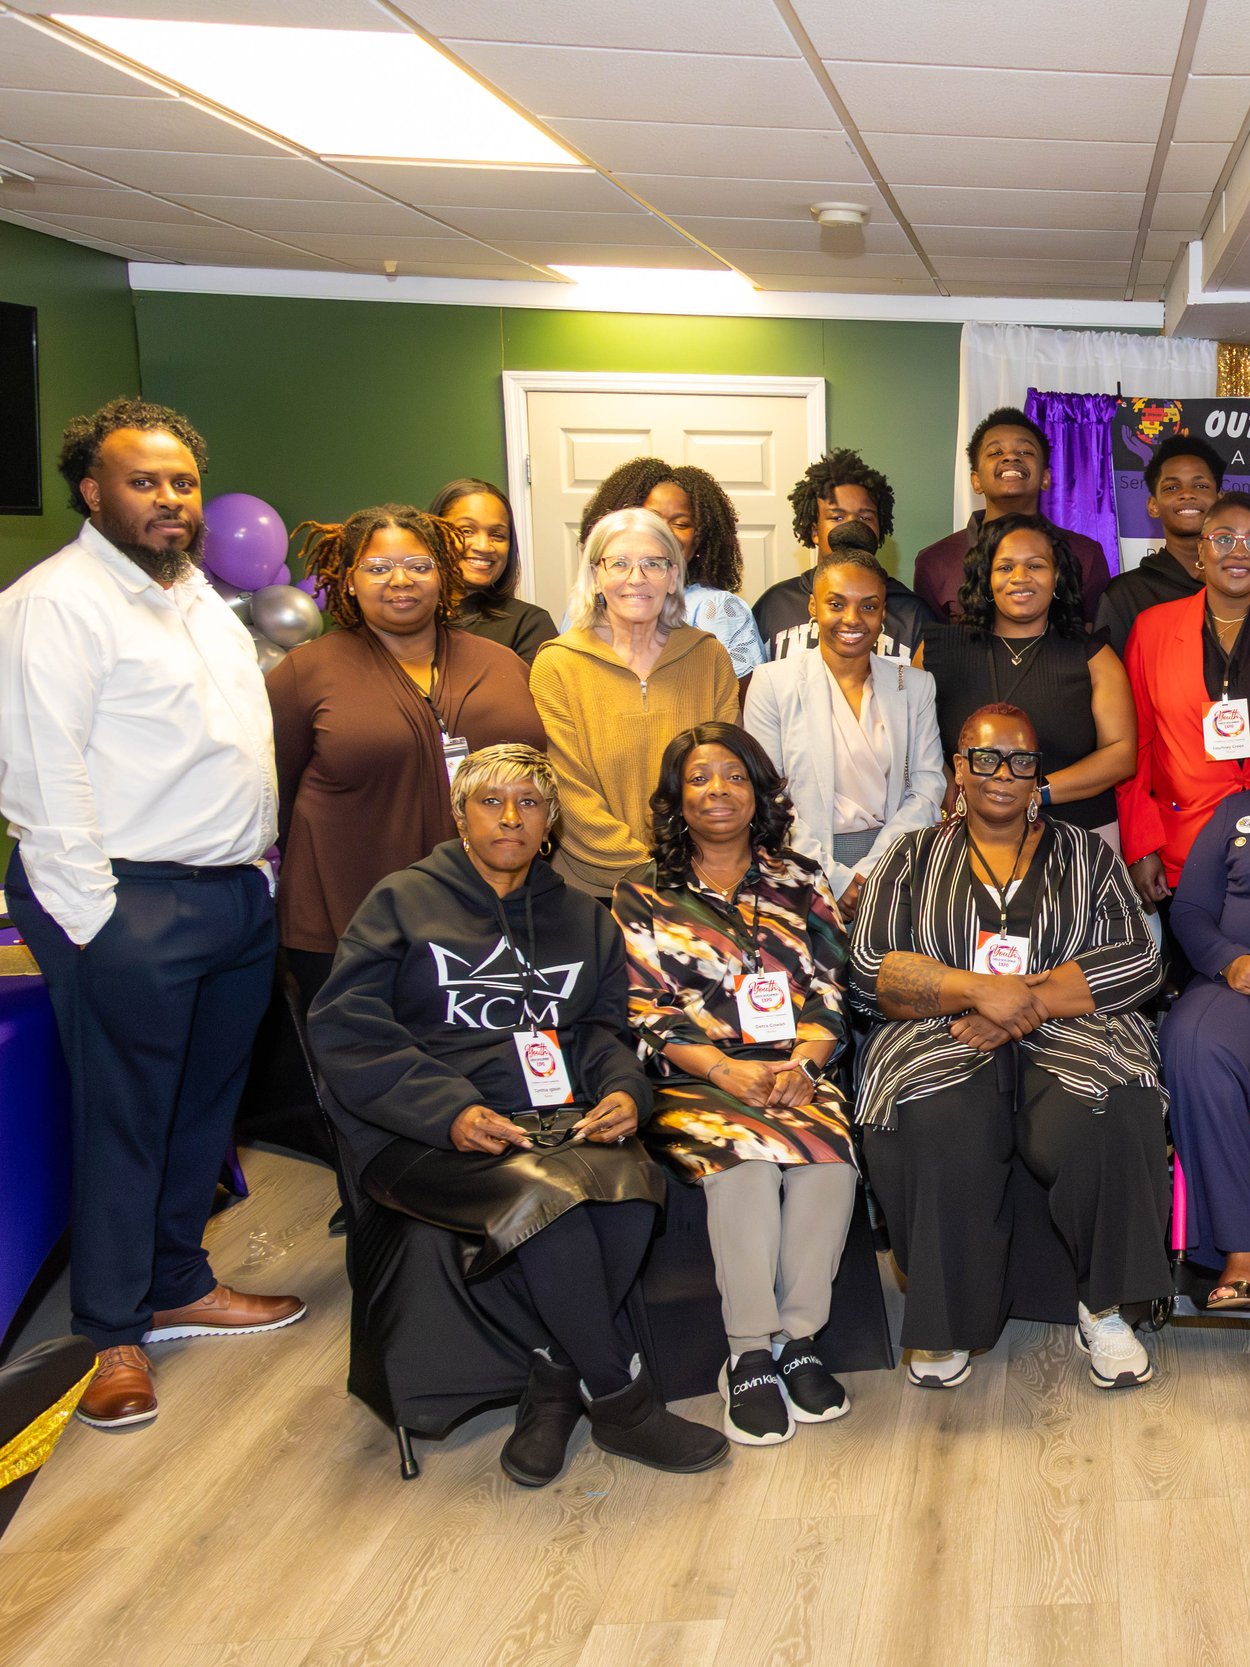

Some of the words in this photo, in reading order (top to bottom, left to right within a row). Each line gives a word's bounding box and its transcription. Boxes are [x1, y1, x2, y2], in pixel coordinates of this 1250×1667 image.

[1231, 450, 1245, 465] A
[444, 989, 560, 1030] KCM
[783, 1355, 812, 1375] Calvin
[733, 1377, 763, 1395] Calvin
[763, 1374, 778, 1385] Kle
